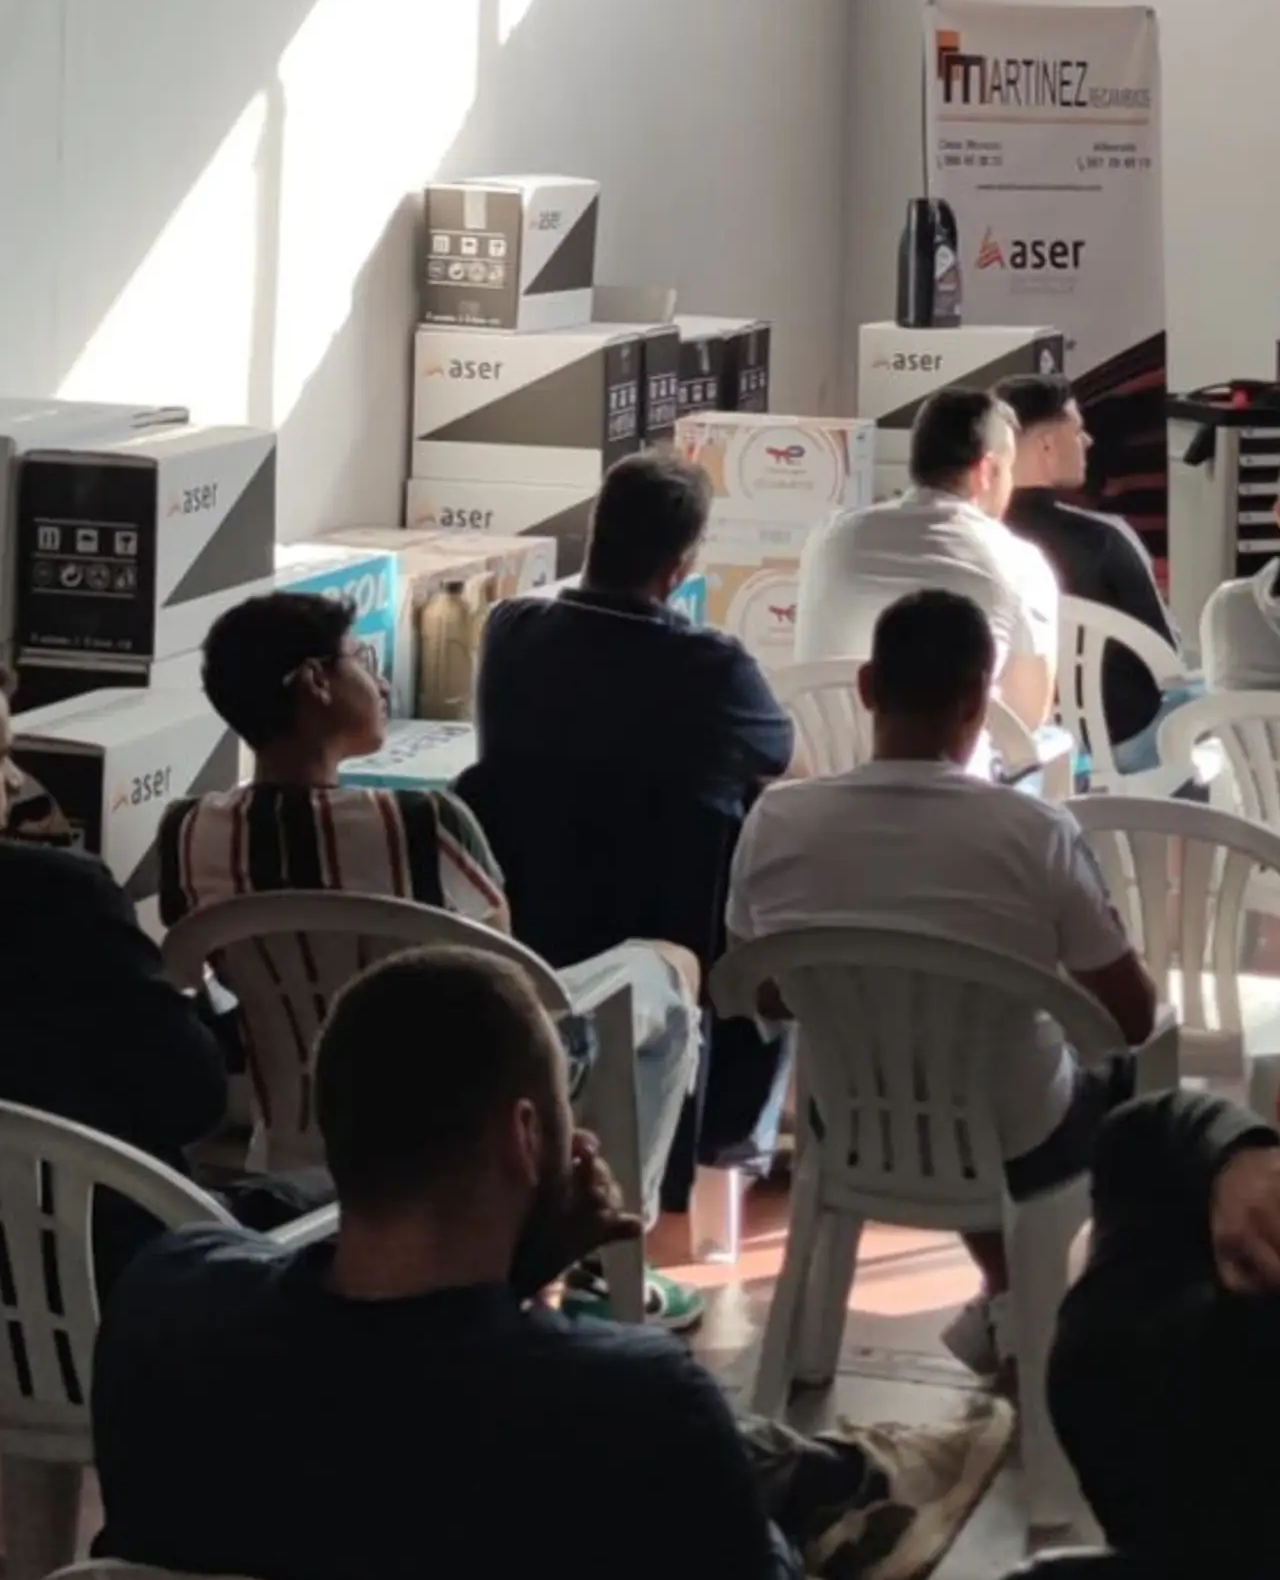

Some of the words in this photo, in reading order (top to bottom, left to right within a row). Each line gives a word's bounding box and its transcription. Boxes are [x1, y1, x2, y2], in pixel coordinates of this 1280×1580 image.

[1009, 238, 1086, 270] aser
[448, 357, 505, 380] aser
[892, 352, 944, 372] aser
[182, 482, 218, 515] aser
[439, 506, 494, 529] aser
[130, 764, 173, 808] aser
